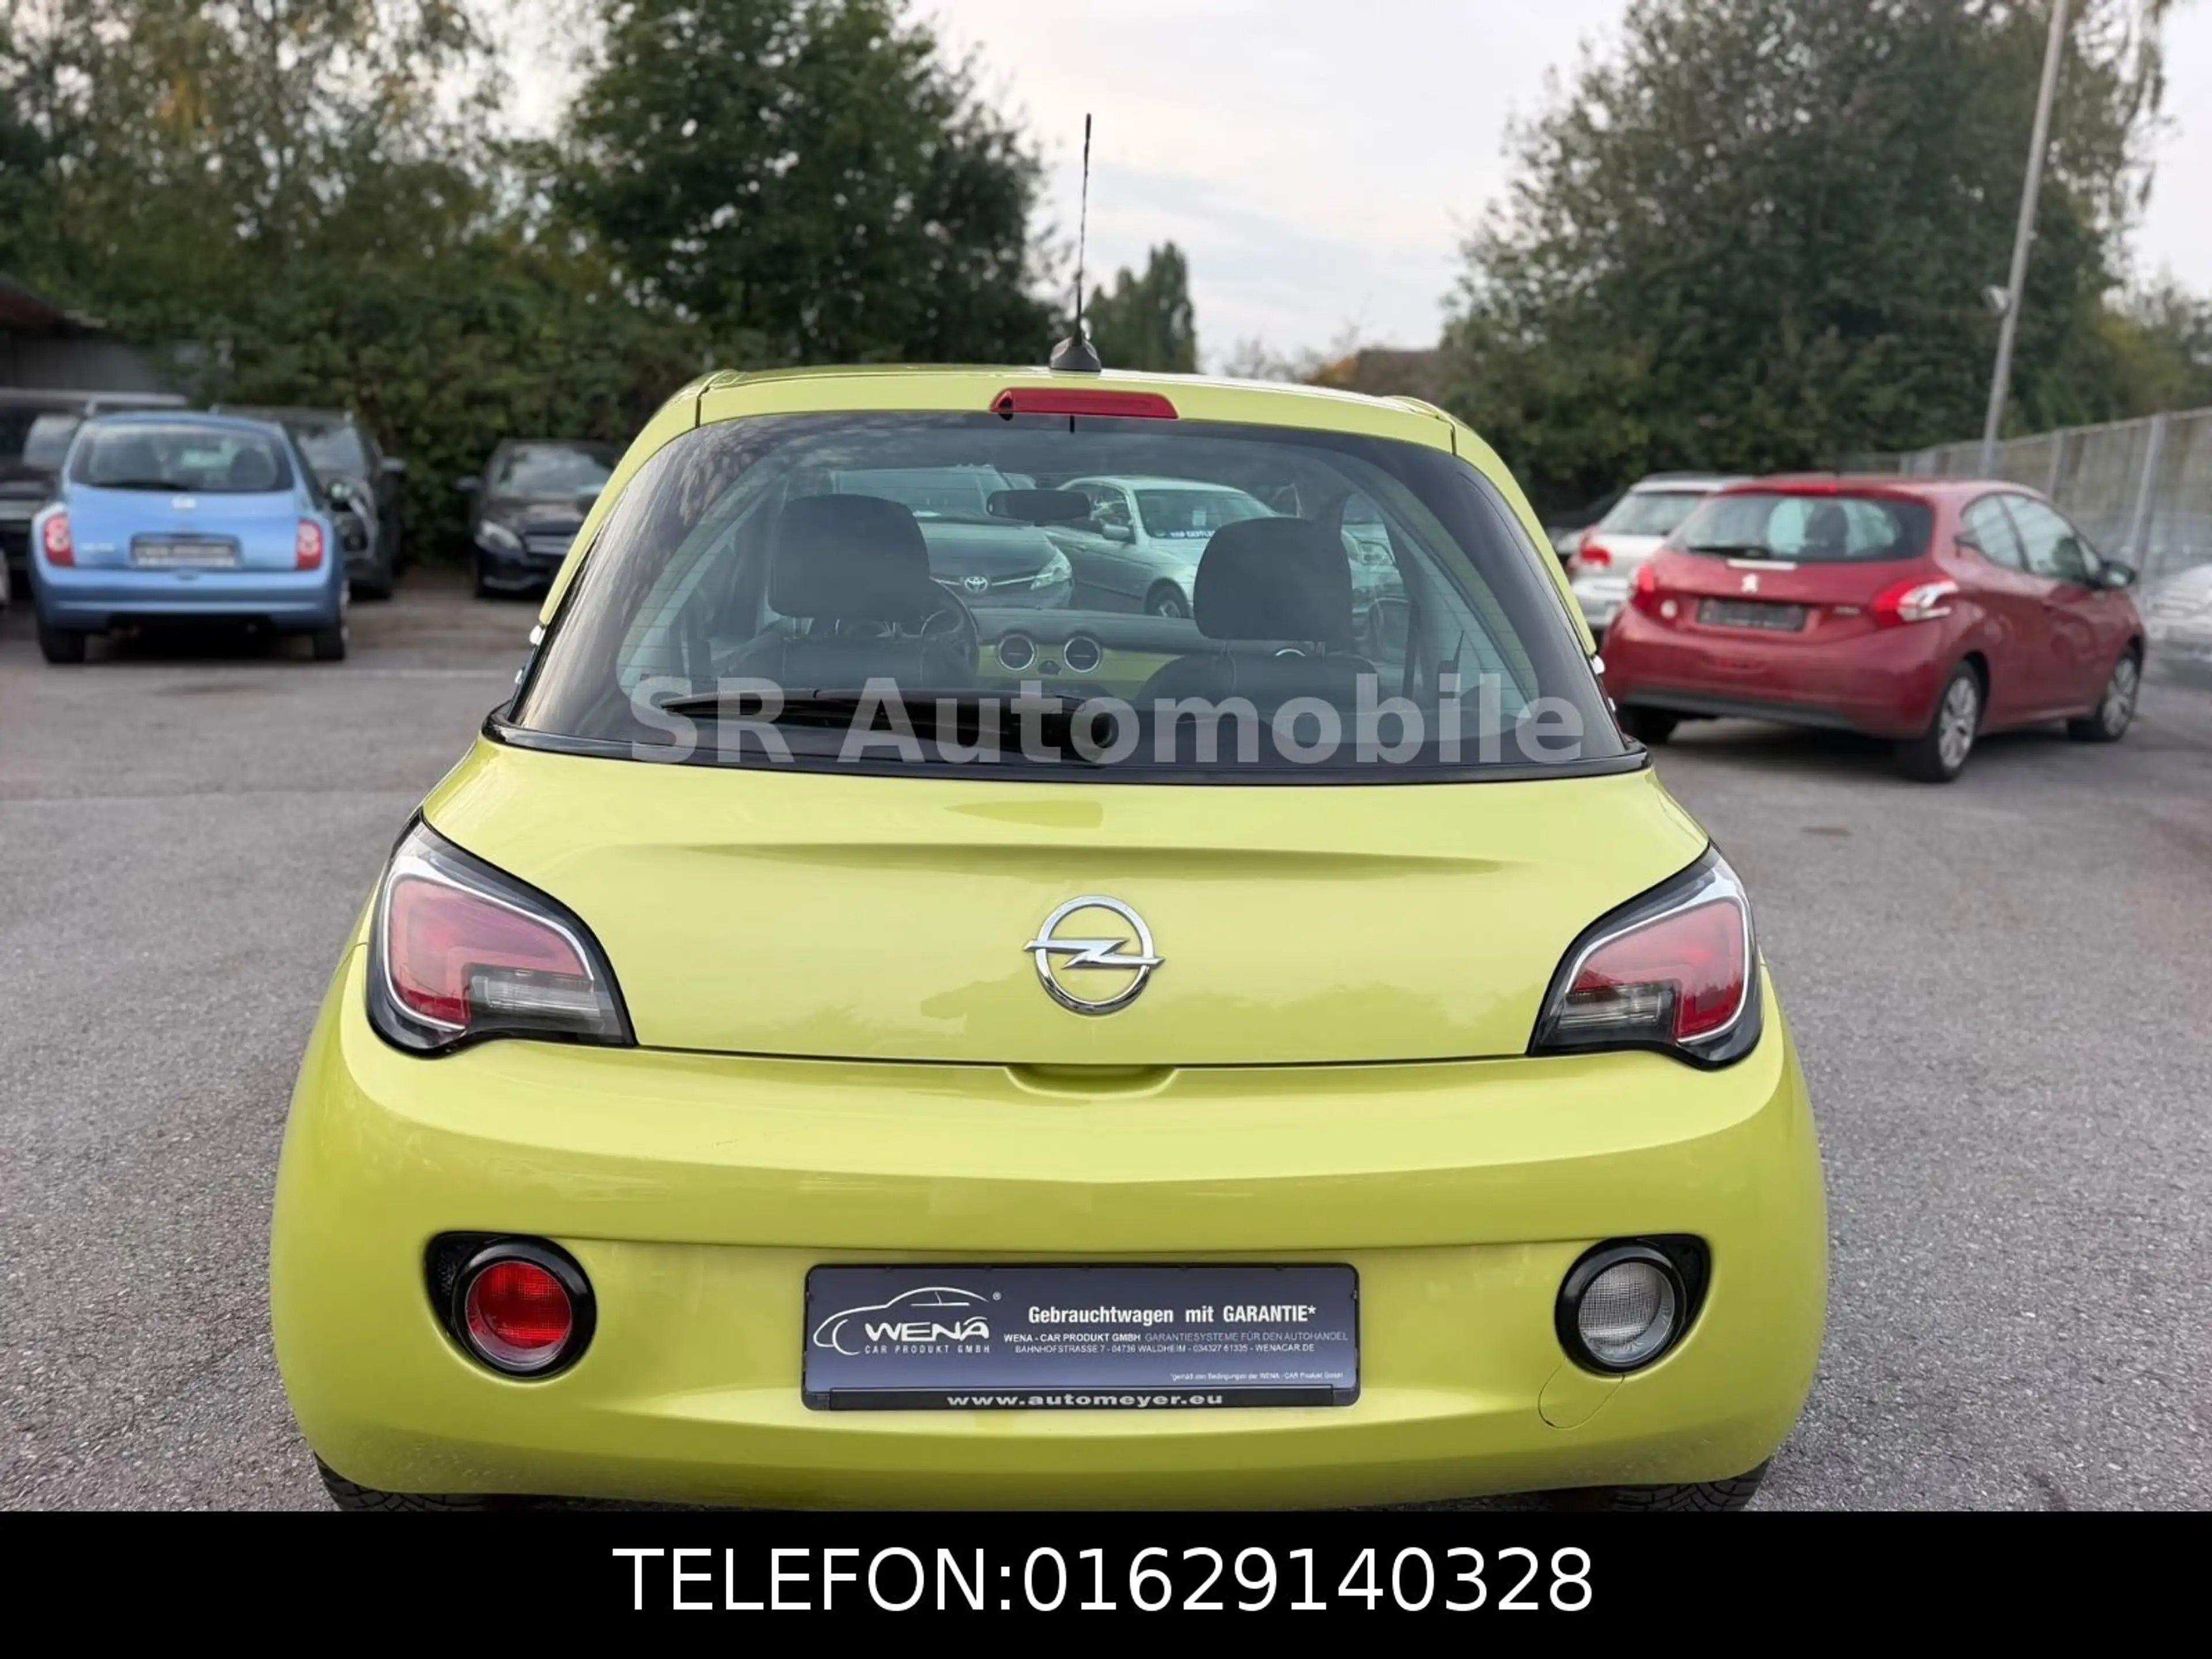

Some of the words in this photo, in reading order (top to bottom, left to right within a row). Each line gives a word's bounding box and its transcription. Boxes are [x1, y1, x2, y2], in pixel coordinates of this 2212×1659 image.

[1028, 1306, 1174, 1326] Gebrauchtwagen
[1185, 1306, 1214, 1323] mit
[1003, 1334, 1033, 1343] WENA
[1040, 1334, 1061, 1342] CAR
[1063, 1333, 1109, 1342] PRODUKT
[1112, 1332, 1141, 1342] GMBH
[1144, 1332, 1240, 1342] GARANTIESYSTEME
[1241, 1331, 1260, 1341] FÜR
[1262, 1332, 1282, 1340] DEN
[1284, 1331, 1349, 1341] AUTOHANDEL
[865, 1344, 888, 1354] CAR
[895, 1344, 949, 1354] PRODUKT
[957, 1344, 990, 1354] GMBH
[1015, 1344, 1097, 1353] BAHNHOFSTRASSE
[1138, 1344, 1186, 1353] WALDHEIM
[1255, 1343, 1315, 1352] WENACAR.DE
[946, 1393, 1223, 1408] www.automeyer.eu
